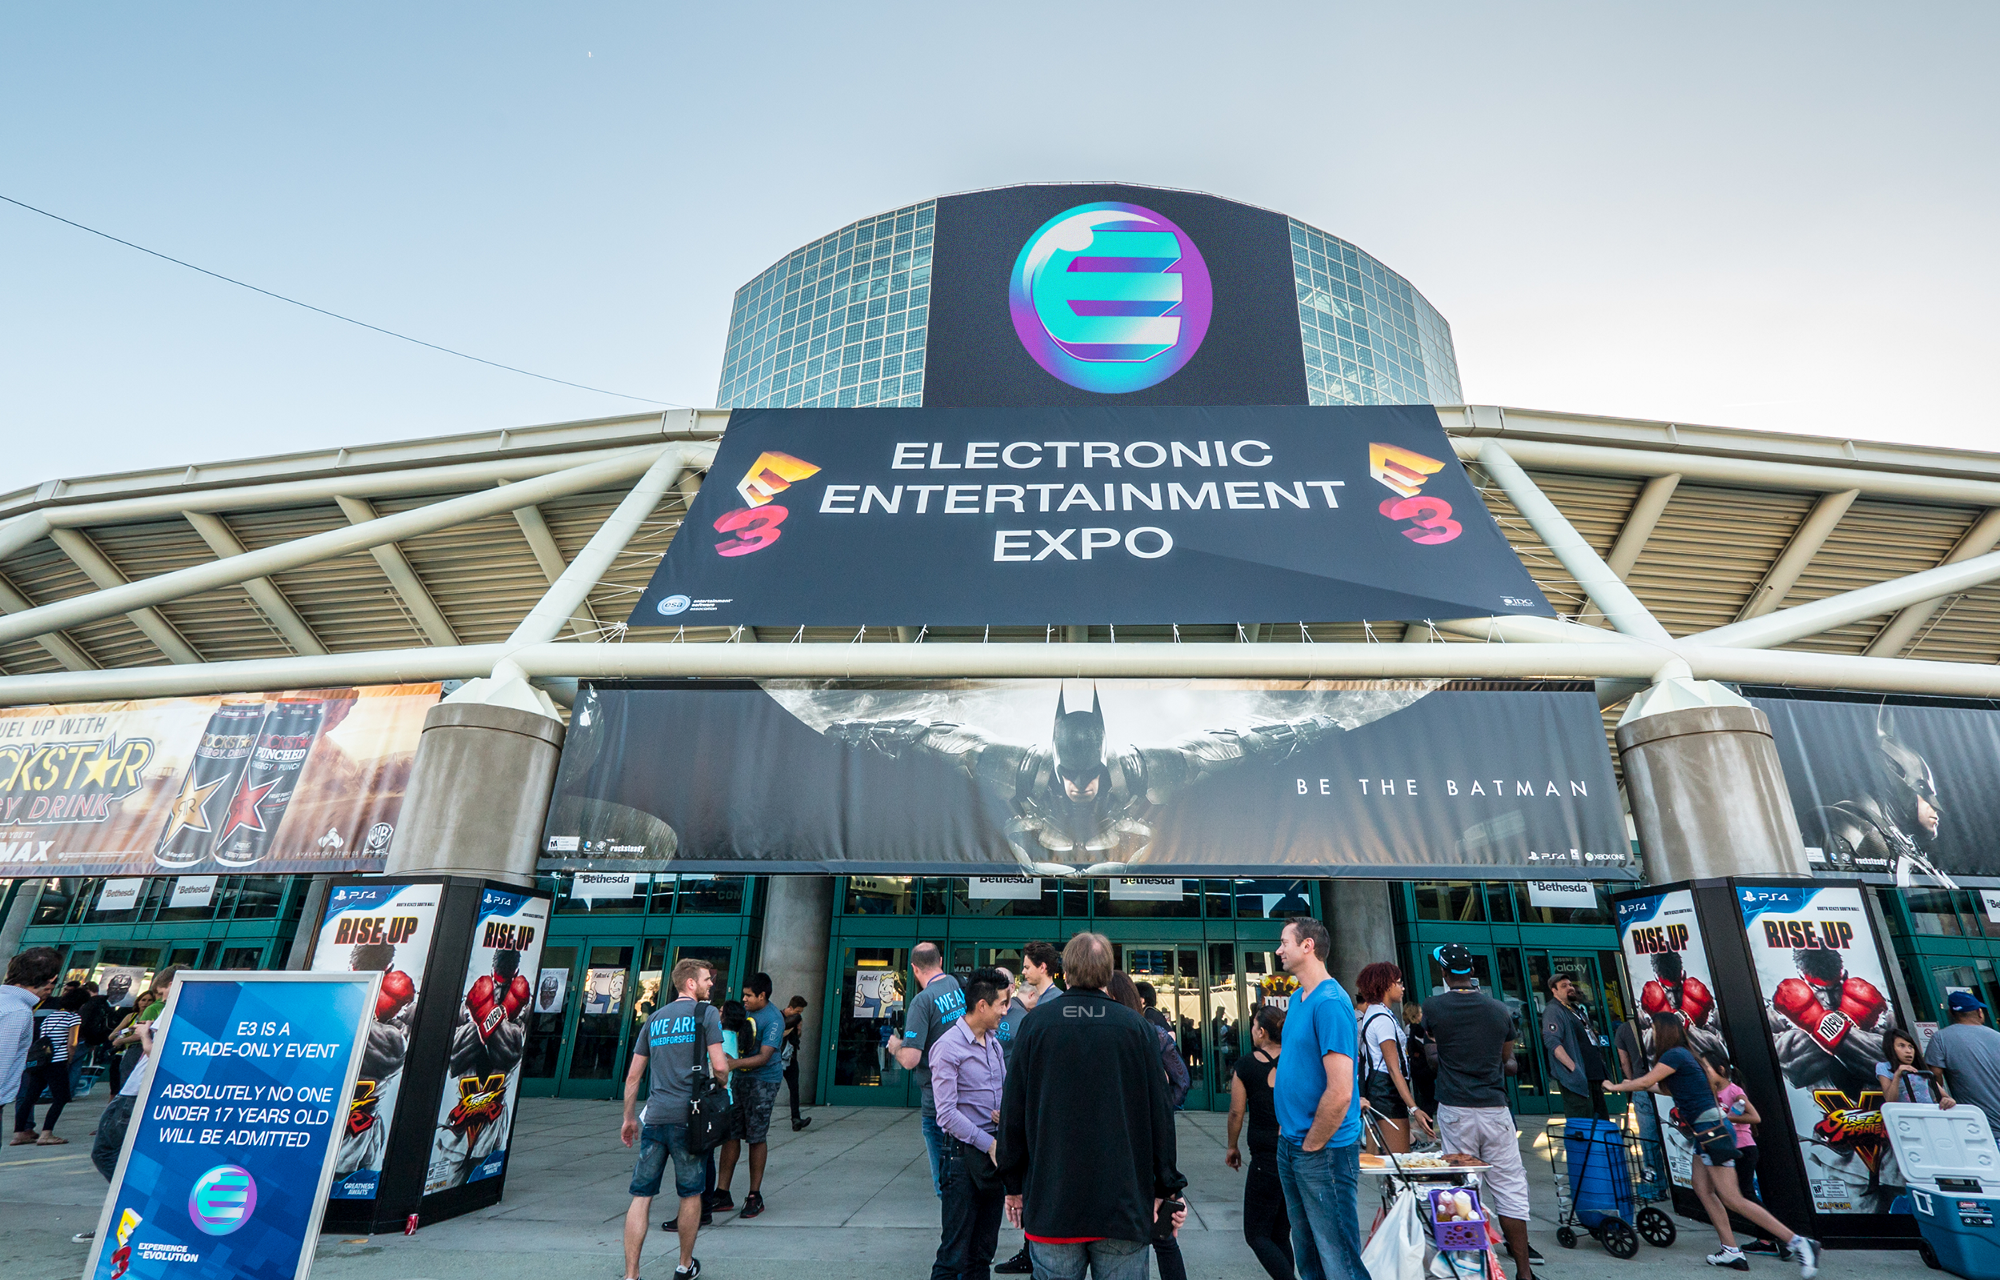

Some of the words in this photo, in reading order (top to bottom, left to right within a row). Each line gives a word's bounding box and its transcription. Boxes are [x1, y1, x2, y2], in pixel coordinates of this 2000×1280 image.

[892, 440, 1273, 471] ELECTRONIC
[819, 481, 1346, 514] ENTERTAINMENT
[993, 526, 1173, 563] EXPO
[31, 719, 55, 736] UP
[59, 716, 107, 735] WITH
[255, 747, 307, 760] PUNCHED
[1297, 779, 1331, 795] BE
[1359, 779, 1418, 796] THE
[1447, 780, 1588, 797] BATMAN
[28, 793, 114, 819] DRINK
[583, 874, 630, 883] Bethesda
[105, 888, 135, 897] Bethesda
[180, 885, 210, 894] Bethesda
[349, 891, 377, 899] PS4
[1538, 881, 1588, 893] Bethesda
[493, 896, 511, 906] PS4
[1758, 893, 1790, 901] PS4
[1628, 903, 1647, 912] PS4
[334, 917, 385, 945] RISE
[387, 916, 419, 945] UP
[483, 921, 517, 950] RISE
[516, 925, 535, 951] UP
[1631, 926, 1668, 954] RISE
[1666, 923, 1689, 952] UP
[1762, 920, 1821, 950] RISE
[1820, 921, 1854, 949] UP
[934, 992, 956, 1014] WE
[1063, 1005, 1105, 1018] ENJ
[237, 1021, 257, 1036] E3
[260, 1022, 276, 1036] IS
[278, 1022, 290, 1036] A
[650, 1018, 671, 1037] WE
[181, 1042, 283, 1057] TRADE-ONLY
[285, 1043, 339, 1058] EVENT
[160, 1084, 266, 1100] ABSOLUTELY
[267, 1086, 293, 1101] NO
[296, 1087, 333, 1103] ONE
[153, 1105, 211, 1121] UNDER
[214, 1107, 233, 1122] 17
[237, 1107, 290, 1124] YEARS
[294, 1110, 329, 1126] OLD
[159, 1128, 196, 1144] WILL
[199, 1129, 221, 1145] BE
[225, 1130, 311, 1148] ADMITTED
[344, 1182, 375, 1190] GREATNESS
[1816, 1201, 1852, 1210] CAPCOM
[138, 1243, 188, 1253] EXPERIENCE
[143, 1251, 199, 1263] EVOLUTION
